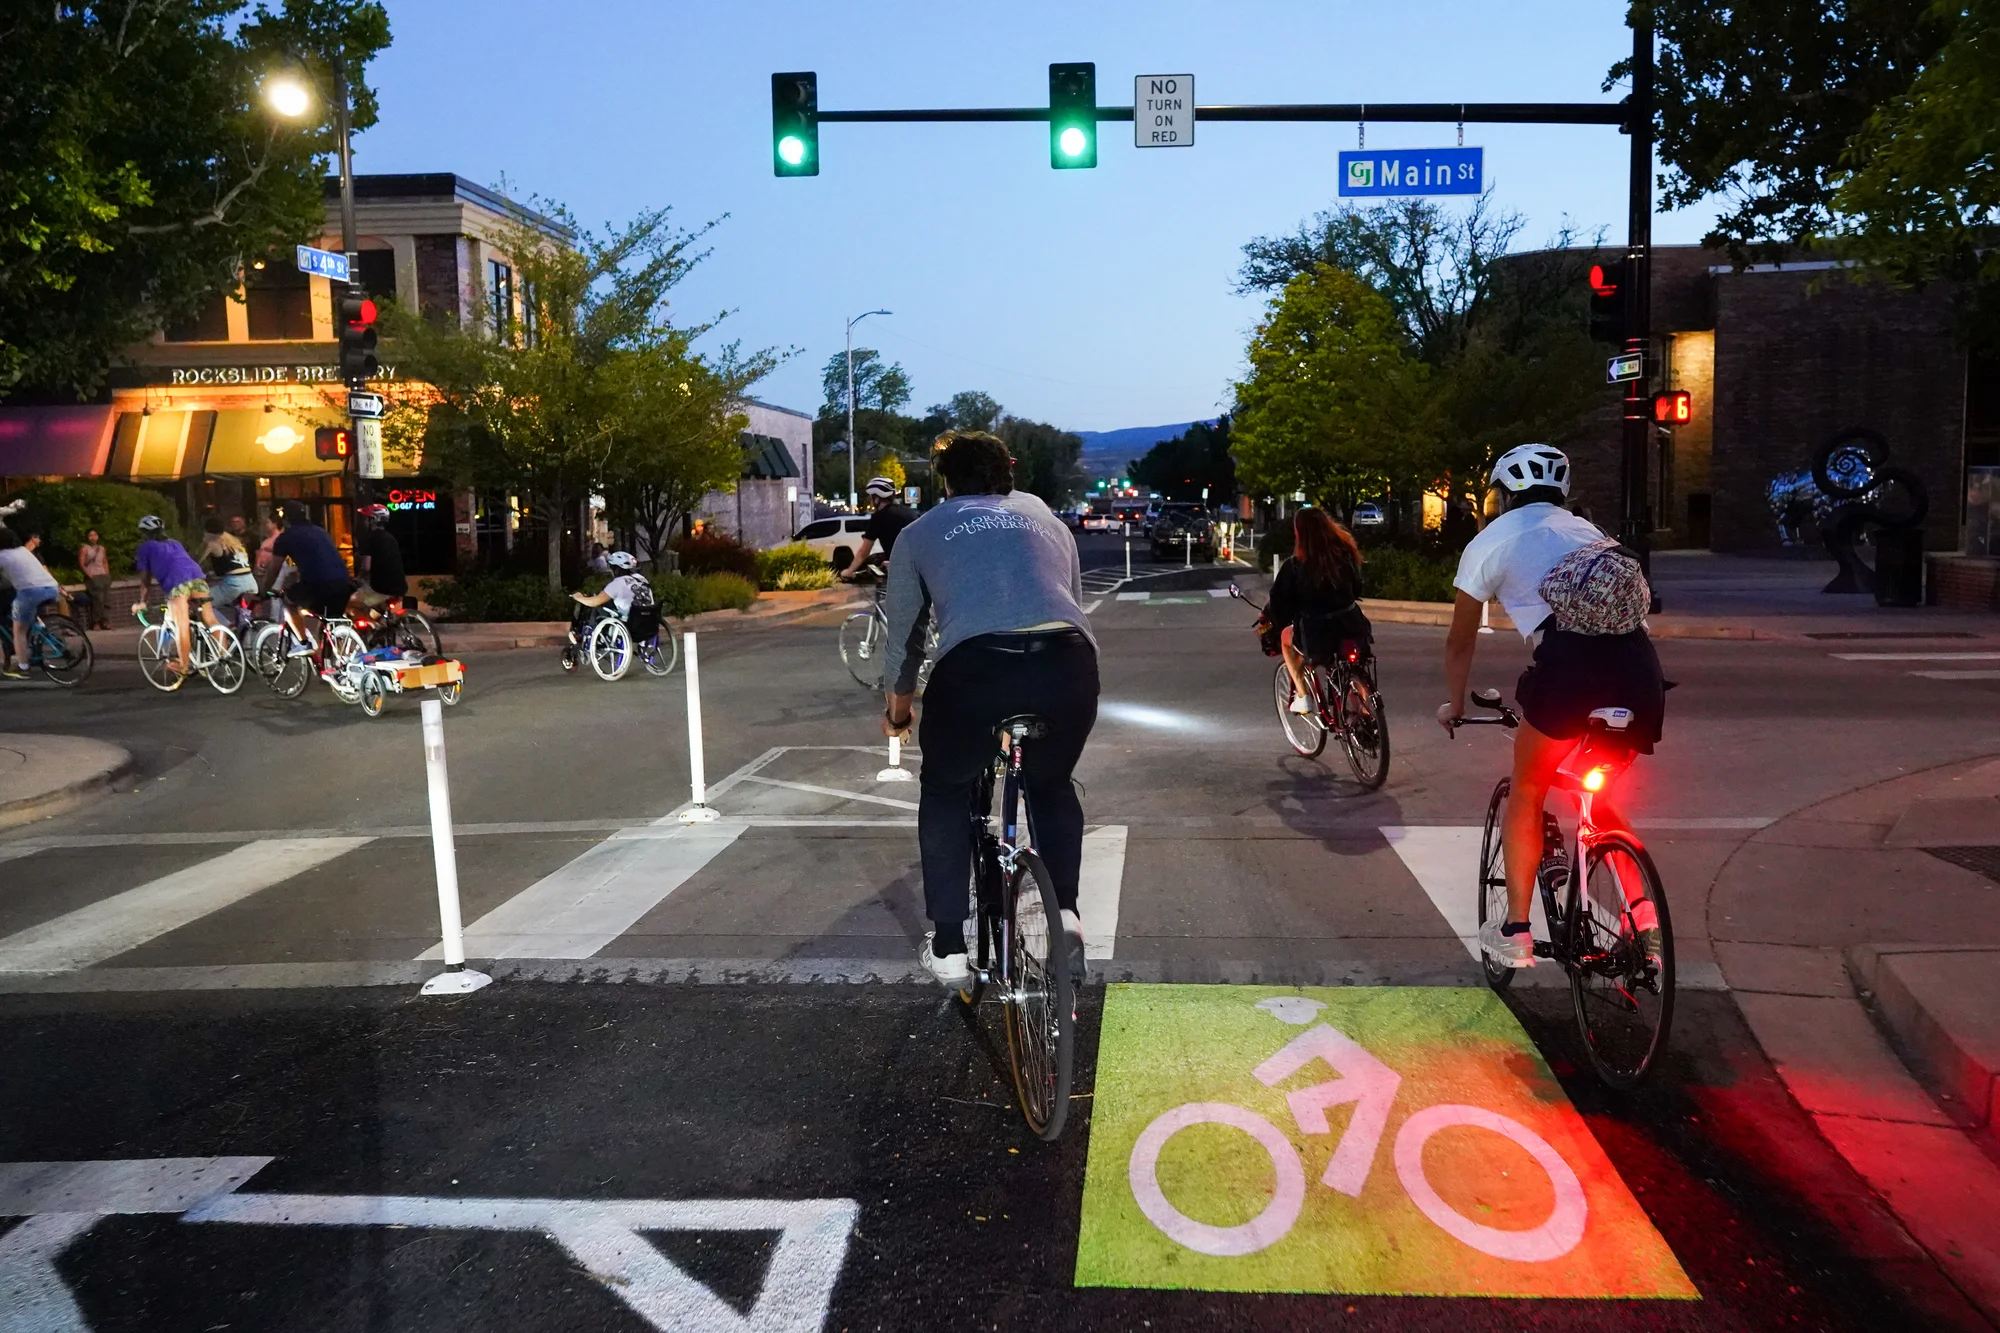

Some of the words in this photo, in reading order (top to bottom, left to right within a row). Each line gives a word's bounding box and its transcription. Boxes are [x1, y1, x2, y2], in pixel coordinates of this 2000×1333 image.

[1151, 80, 1177, 94] NO
[1147, 99, 1182, 111] TURN
[1155, 115, 1173, 127] ON
[1152, 130, 1177, 142] RED
[1381, 159, 1451, 186] Main
[1458, 163, 1475, 180] St
[312, 255, 318, 268] S
[319, 254, 335, 273] 4th
[336, 261, 345, 274] St
[172, 366, 288, 385] ROCKSLIDE
[295, 365, 396, 382] BRERY
[352, 399, 363, 409] ONE
[364, 400, 374, 410] WAY
[1677, 396, 1688, 419] 6
[363, 424, 375, 437] NO
[336, 432, 347, 455] 6
[362, 439, 377, 449] TURN
[366, 452, 375, 461] ON
[389, 489, 436, 503] OPEN
[944, 514, 1024, 541] COLORADO
[966, 520, 1047, 538] UNIVERSITY
